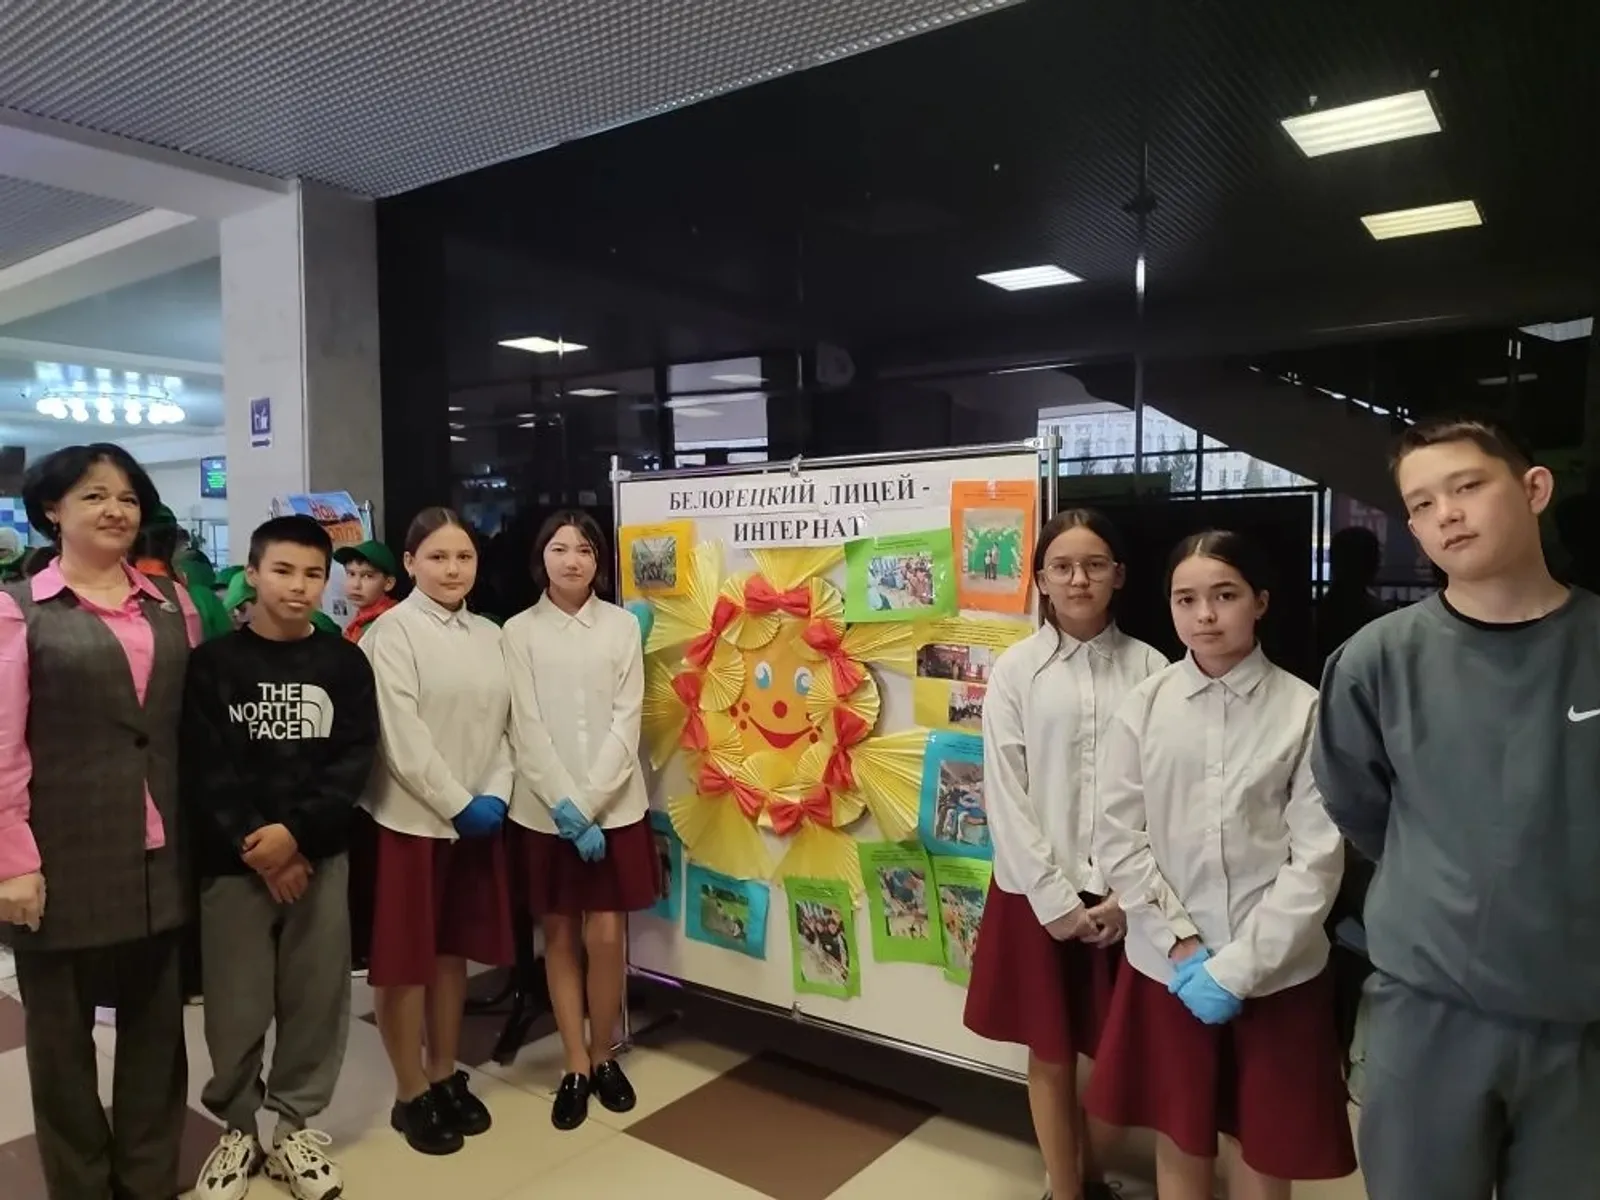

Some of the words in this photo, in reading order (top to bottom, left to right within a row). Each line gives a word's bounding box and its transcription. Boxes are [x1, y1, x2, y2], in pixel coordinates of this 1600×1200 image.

[669, 478, 815, 510] БЕЛОРЕЦКИЙ
[824, 473, 916, 508] ЛИЦЕЙ
[734, 515, 865, 542] ИНТЕРНАТ
[257, 682, 301, 701] THE
[228, 702, 301, 723] NORTH
[248, 720, 301, 741] FACE
